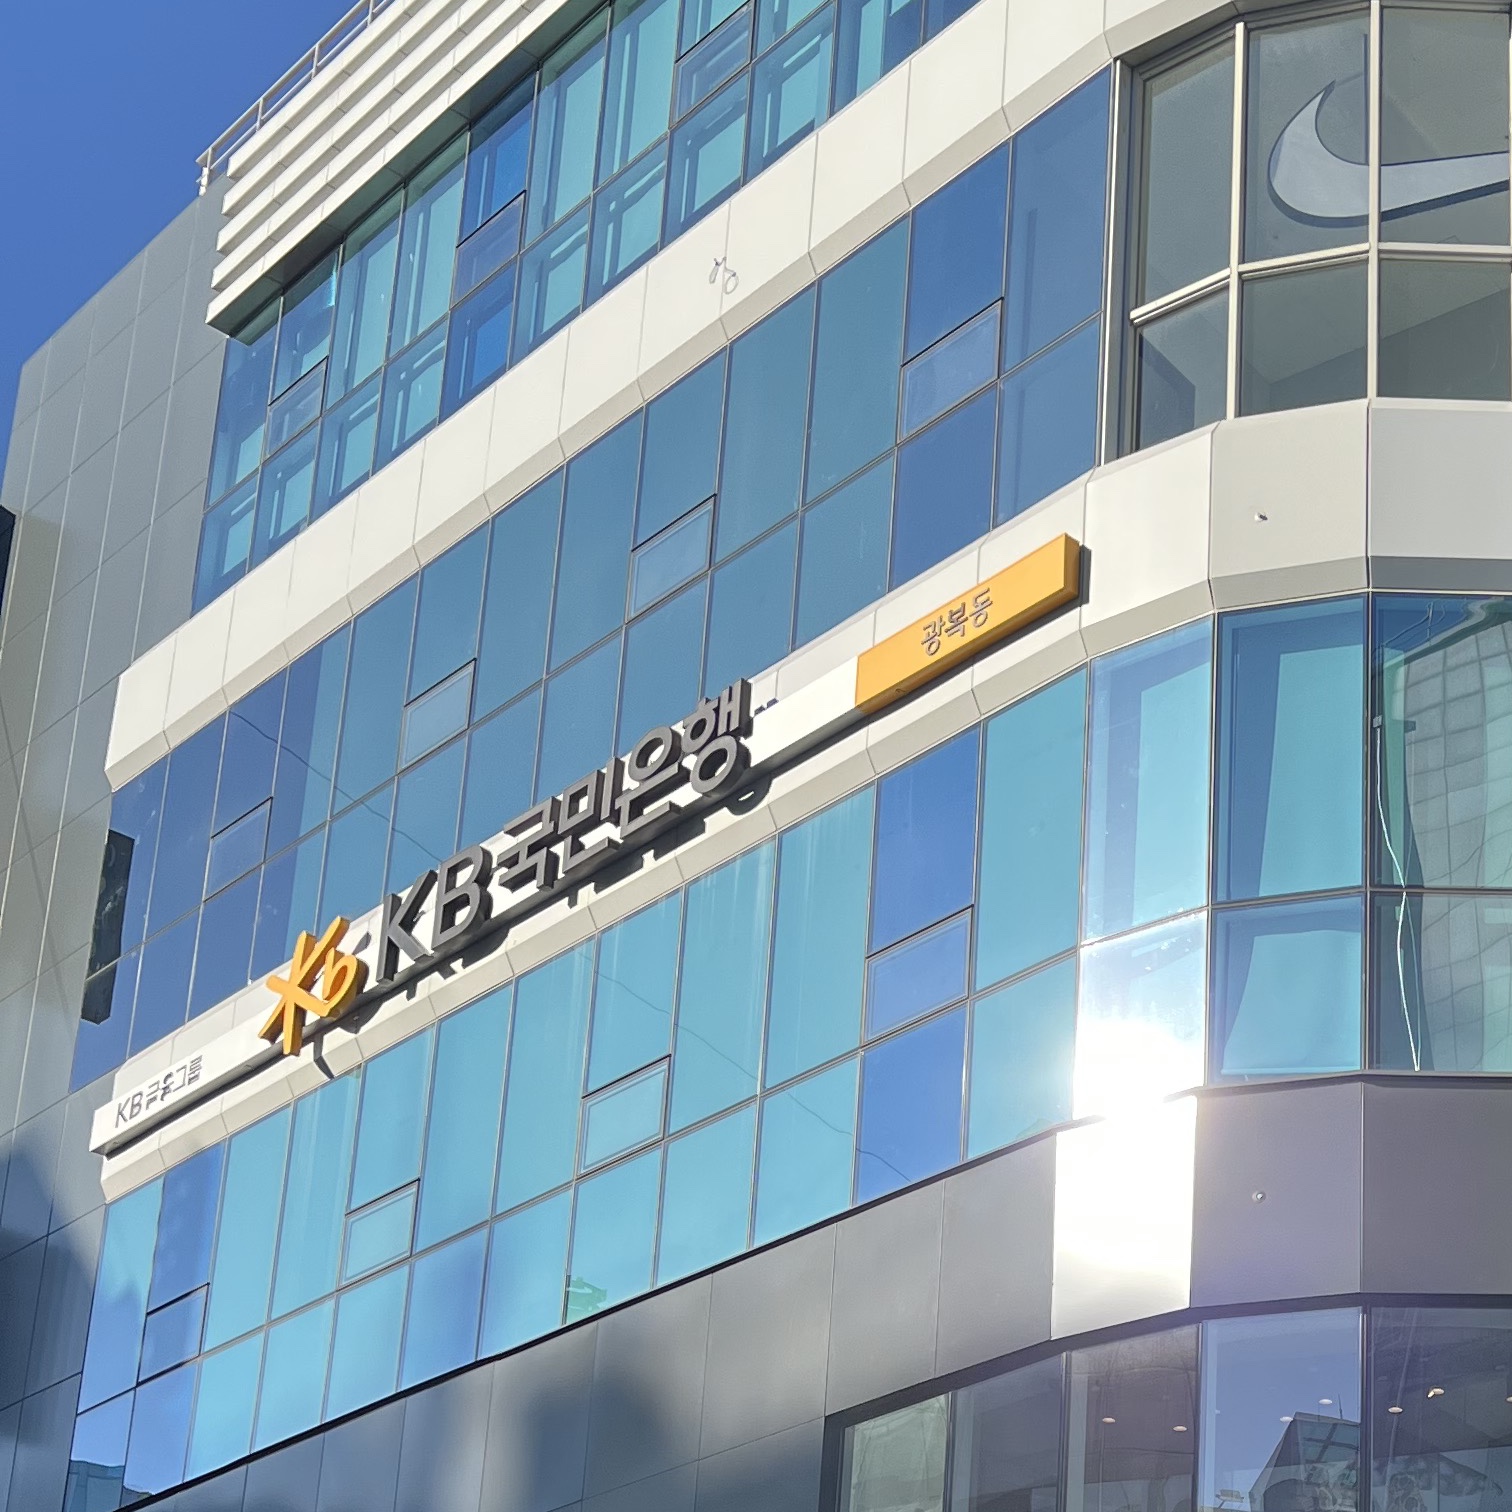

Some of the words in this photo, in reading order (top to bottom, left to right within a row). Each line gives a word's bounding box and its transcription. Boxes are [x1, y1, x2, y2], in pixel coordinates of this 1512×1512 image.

[921, 587, 993, 656] 광복동
[376, 677, 753, 986] KB국민은행
[115, 1055, 203, 1128] KB금융그룹
